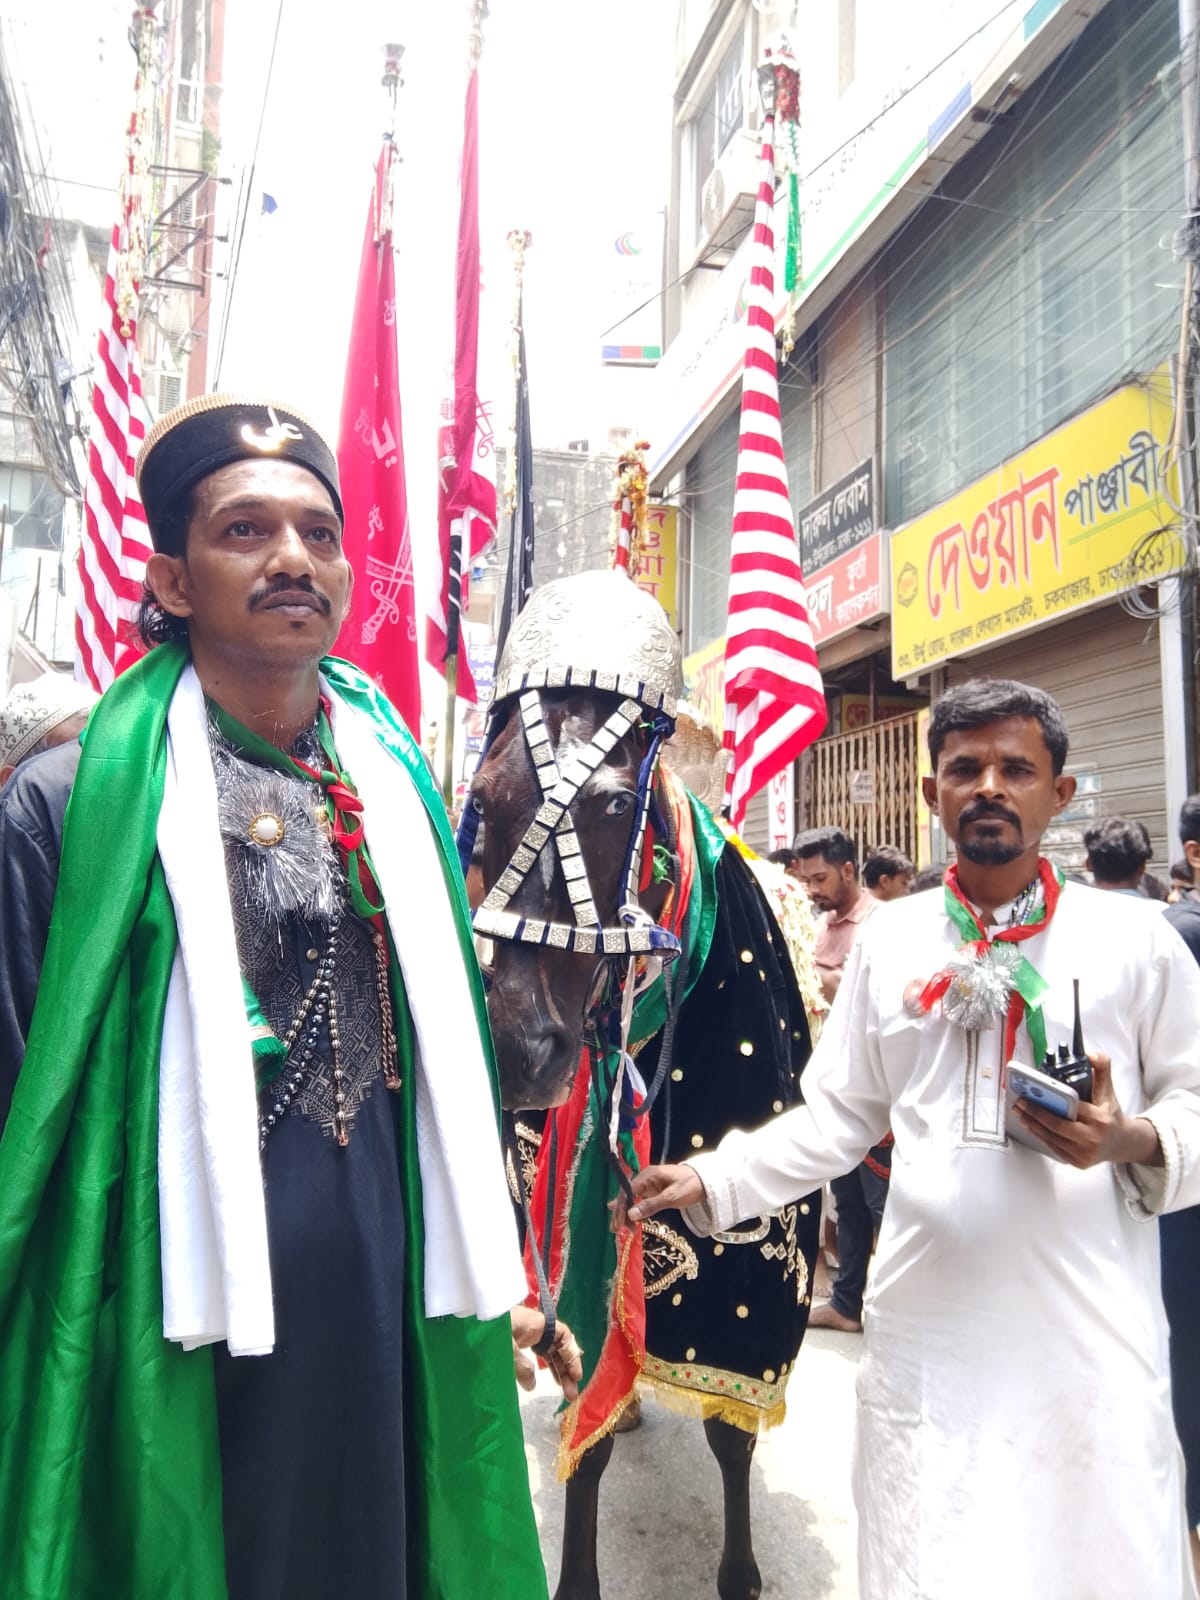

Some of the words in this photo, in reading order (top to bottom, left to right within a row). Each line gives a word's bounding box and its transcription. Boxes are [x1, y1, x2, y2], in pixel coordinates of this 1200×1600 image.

[802, 500, 831, 546] দারুল
[833, 473, 870, 527] লেবাস
[927, 467, 1060, 619] দেওয়ান
[1064, 431, 1159, 525] পাঞ্জাবী
